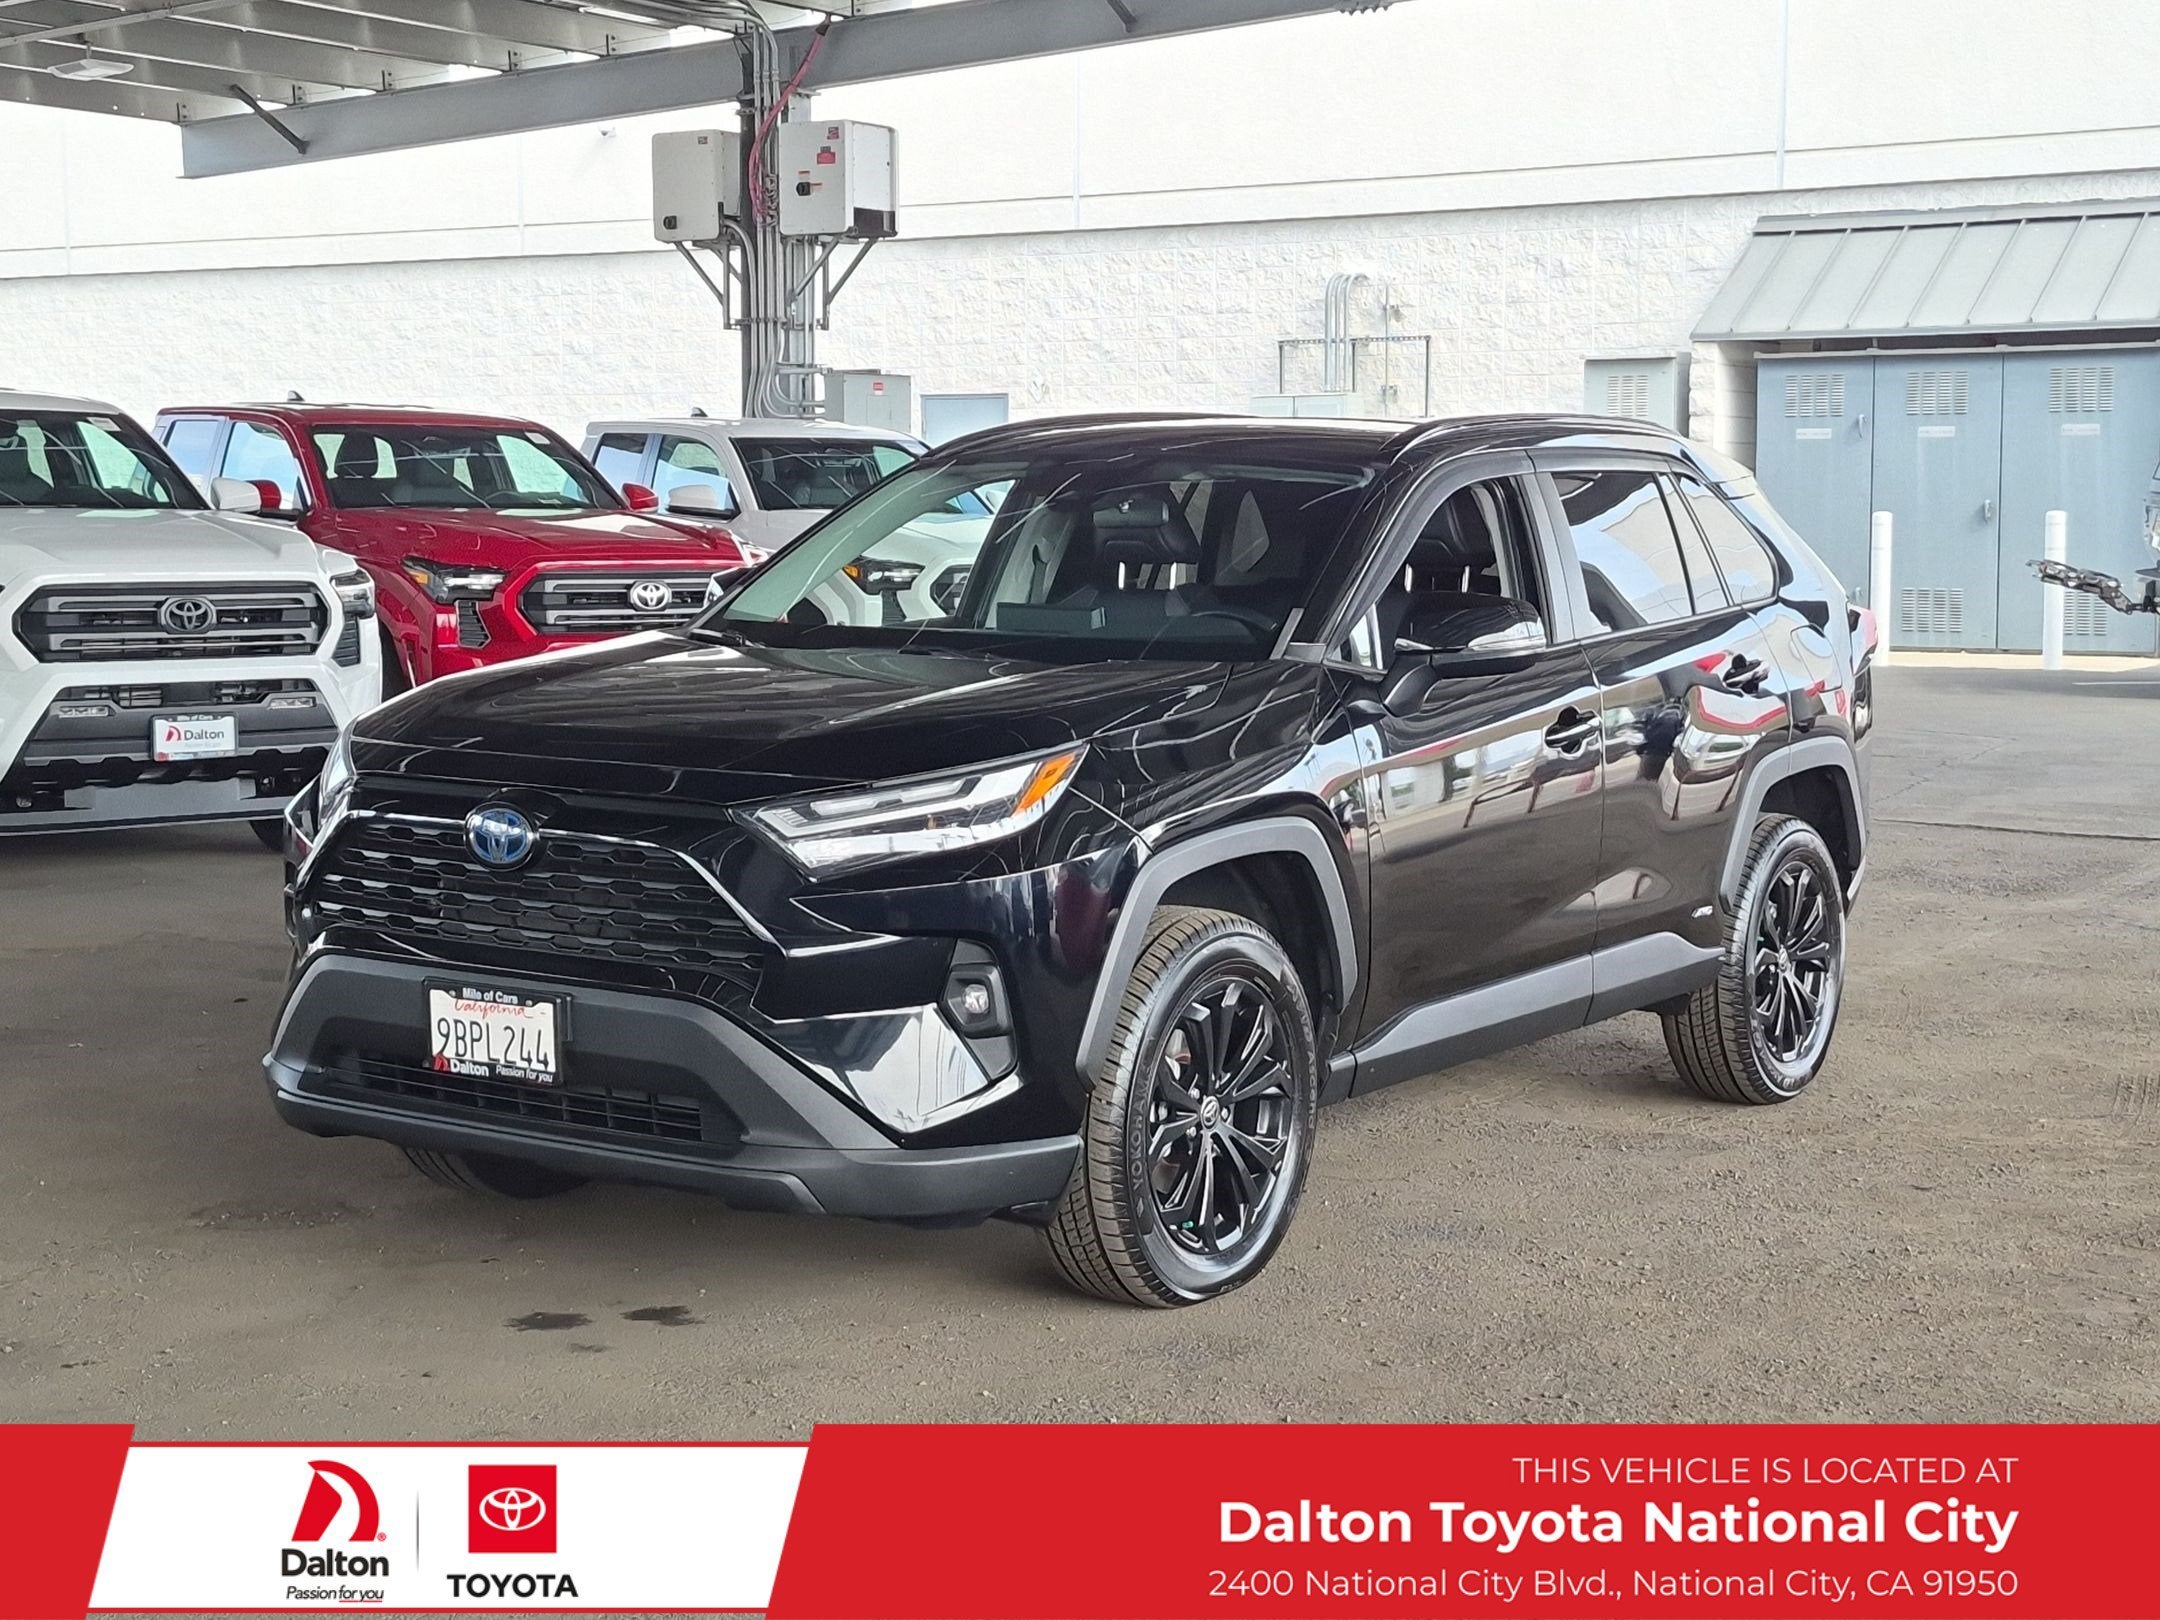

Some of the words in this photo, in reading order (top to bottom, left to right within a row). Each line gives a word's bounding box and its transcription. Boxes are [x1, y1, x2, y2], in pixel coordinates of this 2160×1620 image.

[184, 729, 224, 741] Dalton
[462, 987, 482, 1000] Mile
[483, 990, 494, 1001] of
[495, 991, 518, 1004] Cars
[437, 1017, 549, 1071] 9BPL244
[450, 1058, 489, 1077] Dalton
[496, 1064, 525, 1079] Passion
[525, 1067, 538, 1079] for
[538, 1071, 554, 1083] you
